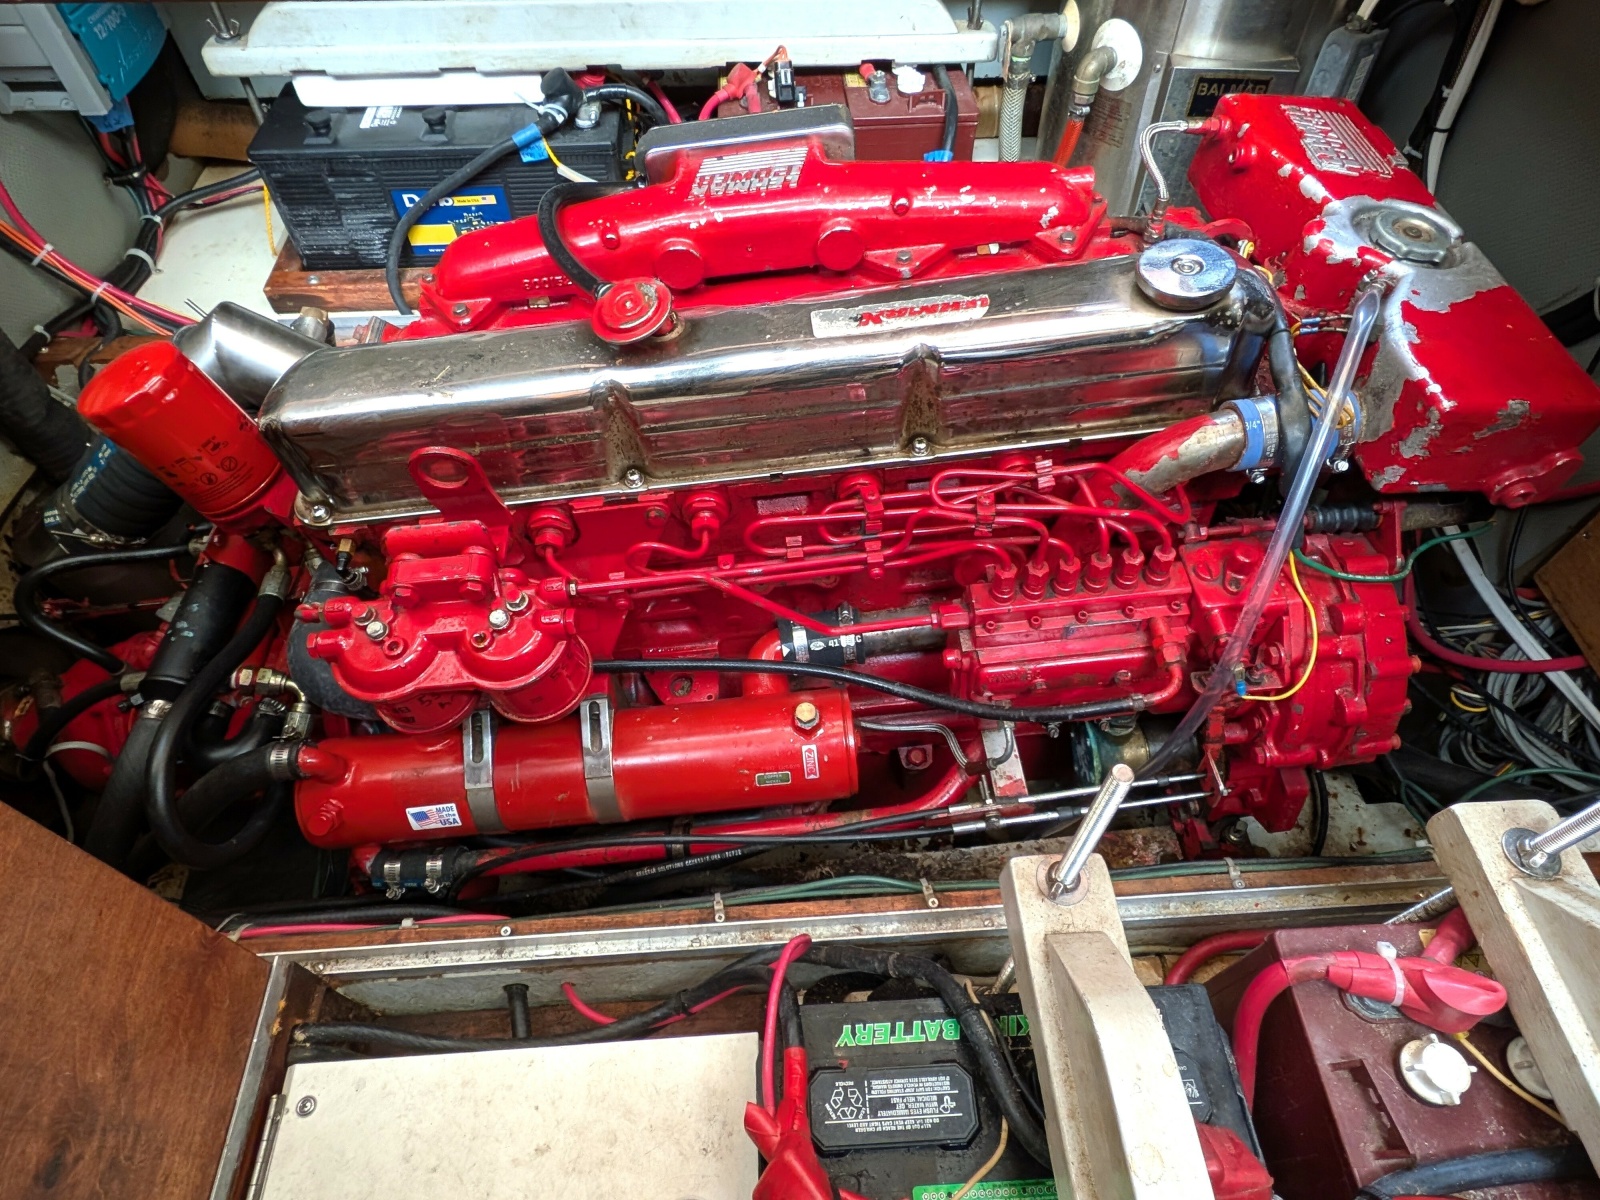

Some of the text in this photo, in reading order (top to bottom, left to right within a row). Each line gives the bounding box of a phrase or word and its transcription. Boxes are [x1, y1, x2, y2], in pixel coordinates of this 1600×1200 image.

[805, 751, 816, 773] ZINC
[435, 805, 455, 813] MADE
[440, 818, 459, 826] USA
[835, 1018, 961, 1047] BATTERY
